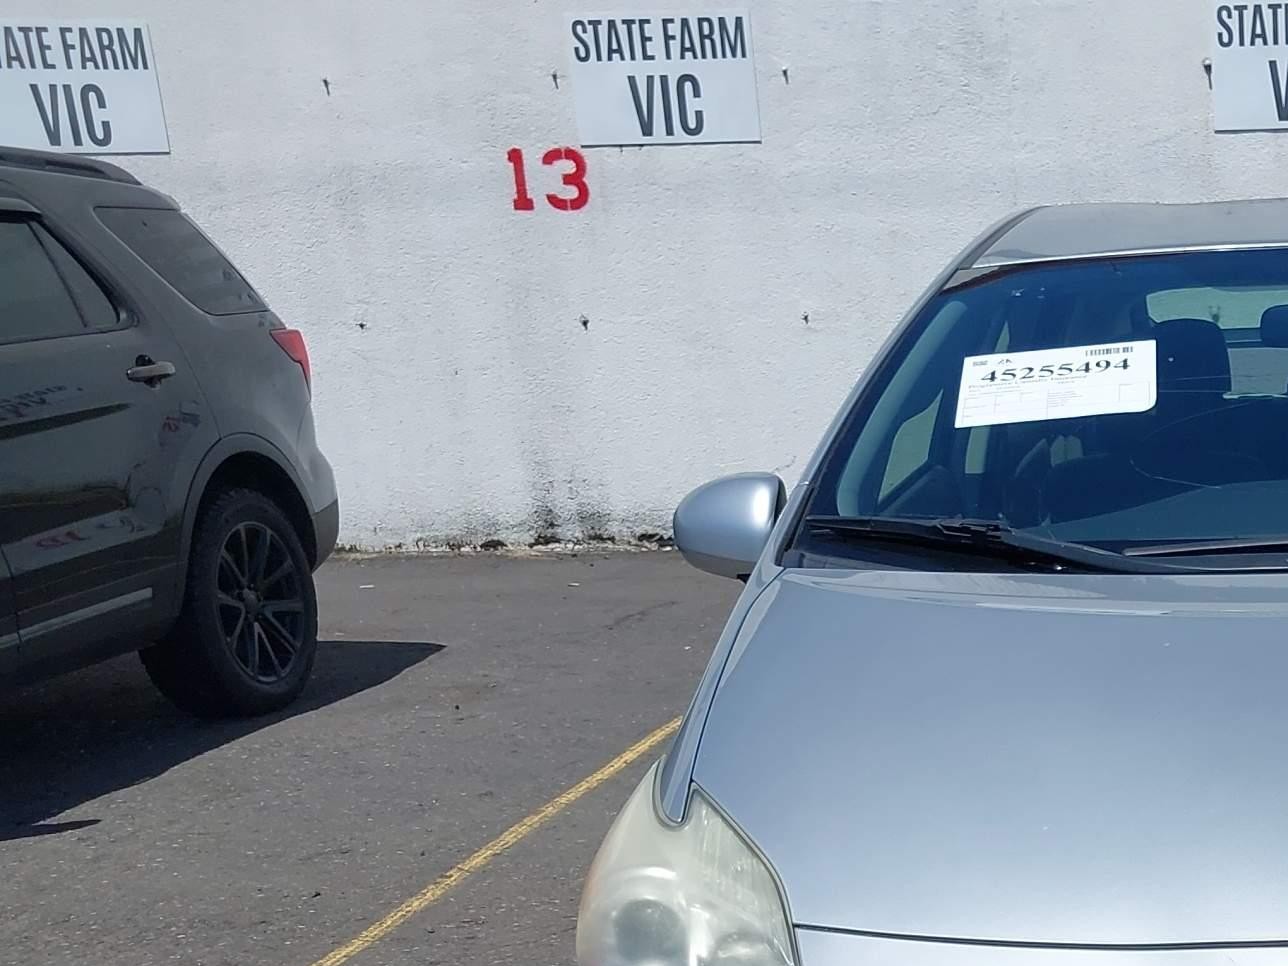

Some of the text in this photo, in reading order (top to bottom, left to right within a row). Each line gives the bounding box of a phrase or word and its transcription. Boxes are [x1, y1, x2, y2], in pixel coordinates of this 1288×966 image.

[0, 26, 149, 70] ATE FARM
[571, 16, 747, 62] STATE FARM
[29, 83, 112, 147] VIC
[627, 74, 704, 136] VIC
[507, 148, 589, 211] 13
[981, 358, 1131, 382] 45255494
